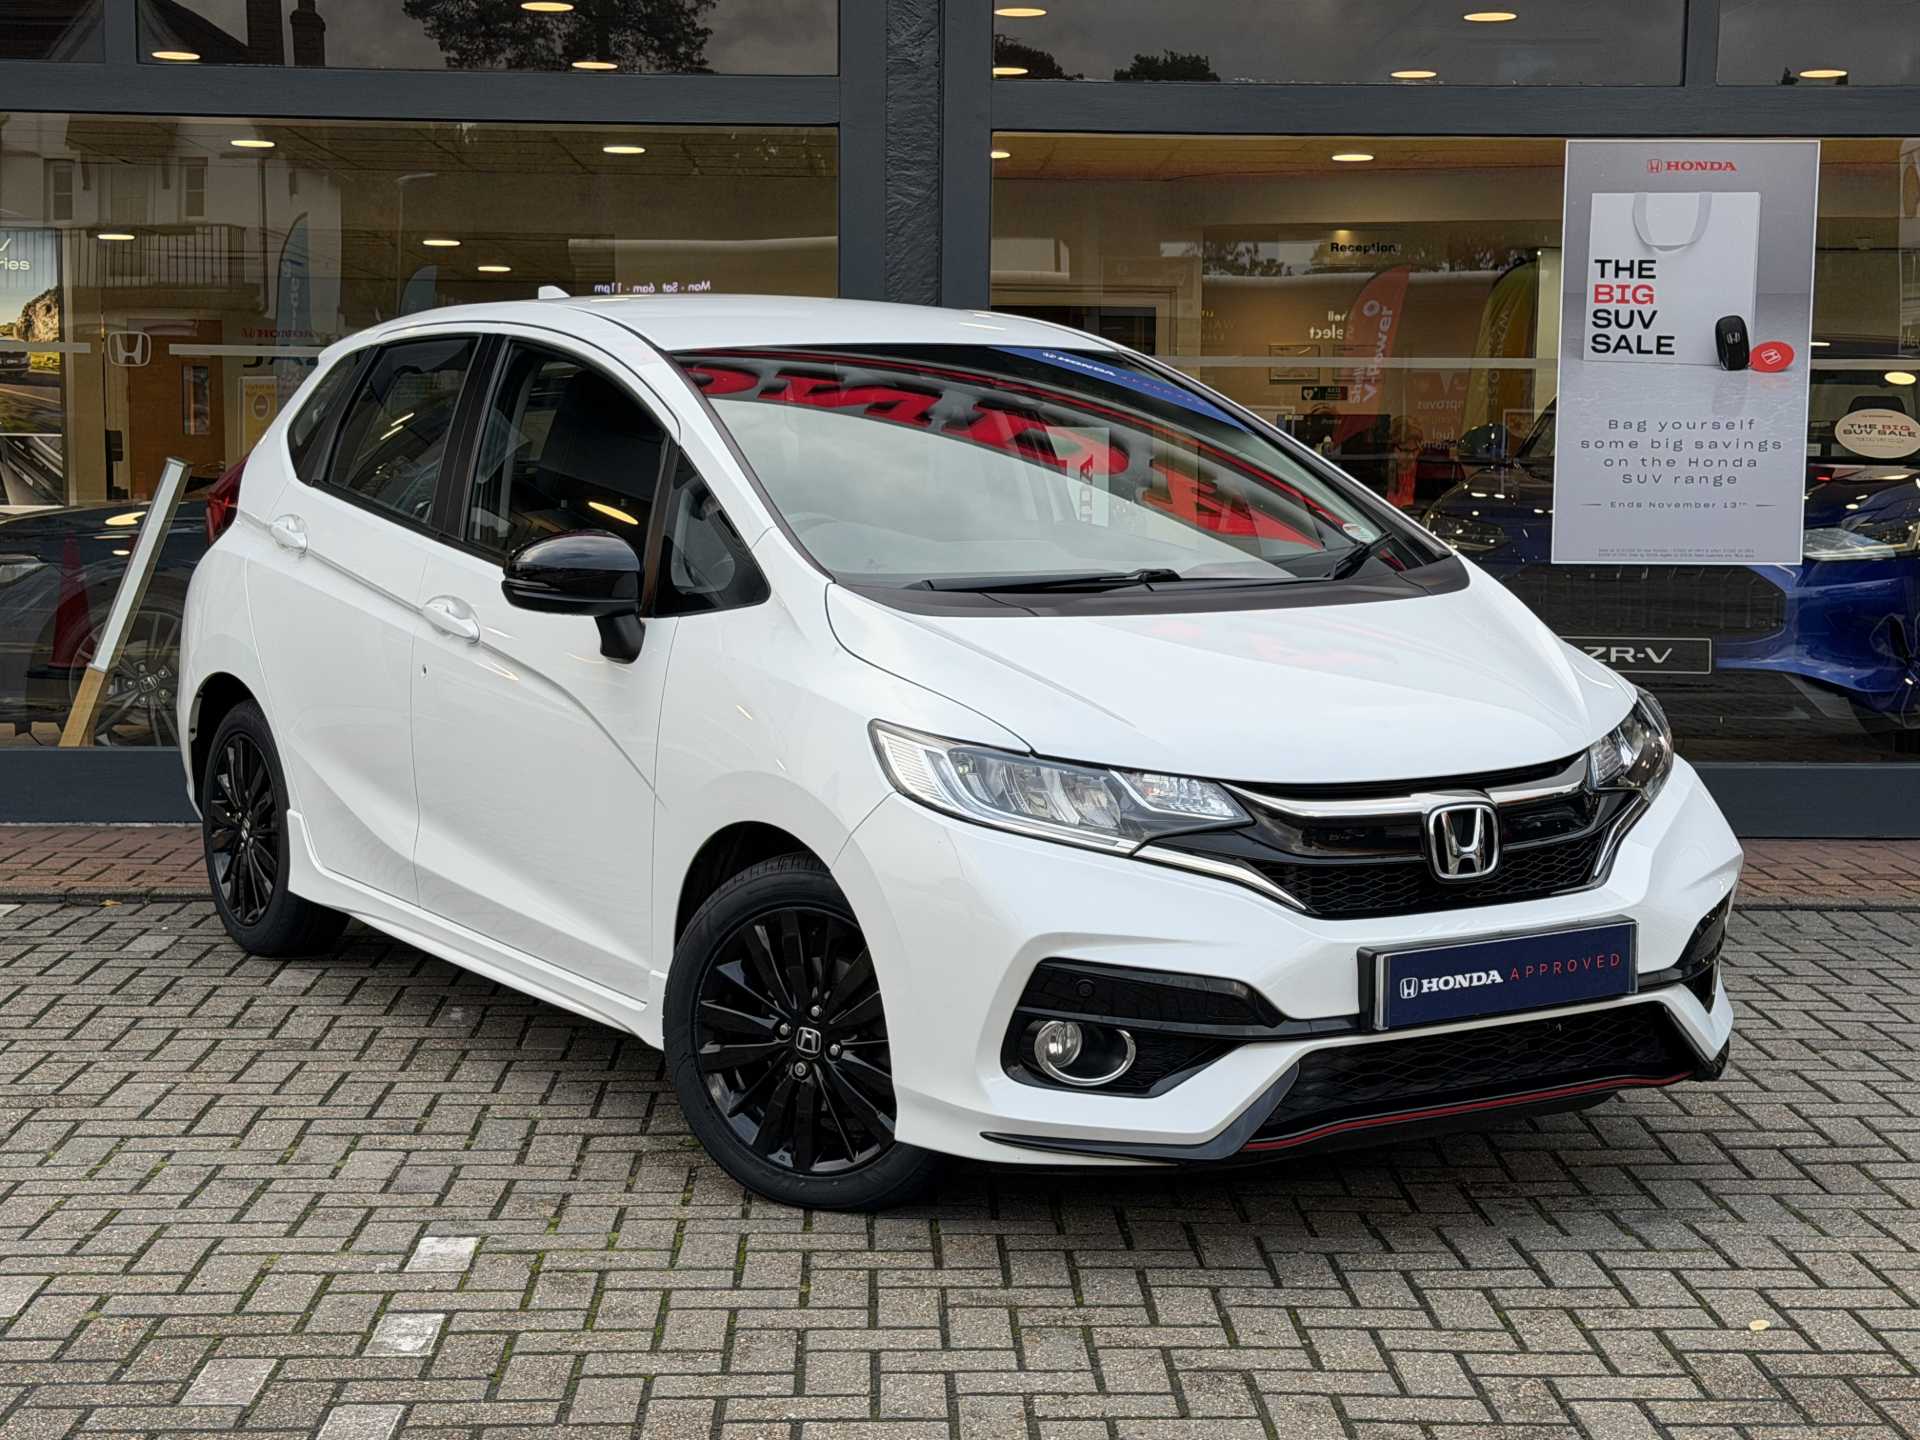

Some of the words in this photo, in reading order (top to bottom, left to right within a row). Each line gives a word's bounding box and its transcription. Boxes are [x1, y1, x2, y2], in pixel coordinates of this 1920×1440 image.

[1666, 160, 1737, 172] HONDA
[1330, 242, 1397, 254] Reception
[1594, 259, 1657, 279] THE
[1593, 284, 1655, 304] BIG
[1591, 308, 1658, 330] SUV
[1590, 334, 1675, 355] SALE
[1608, 419, 1647, 433] Bag
[1658, 419, 1756, 433] yourself
[1580, 439, 1640, 449] some
[1650, 438, 1684, 452] big
[1694, 438, 1782, 452] savings
[1603, 458, 1630, 468] on
[1641, 457, 1676, 468] the
[1688, 457, 1758, 468] Honda
[1622, 473, 1663, 484] SUV
[1674, 475, 1738, 487] range
[1610, 501, 1643, 509] Ends
[1584, 646, 1673, 664] ZR-V
[1420, 969, 1504, 993] HONDA
[1510, 953, 1621, 981] APPROVED
